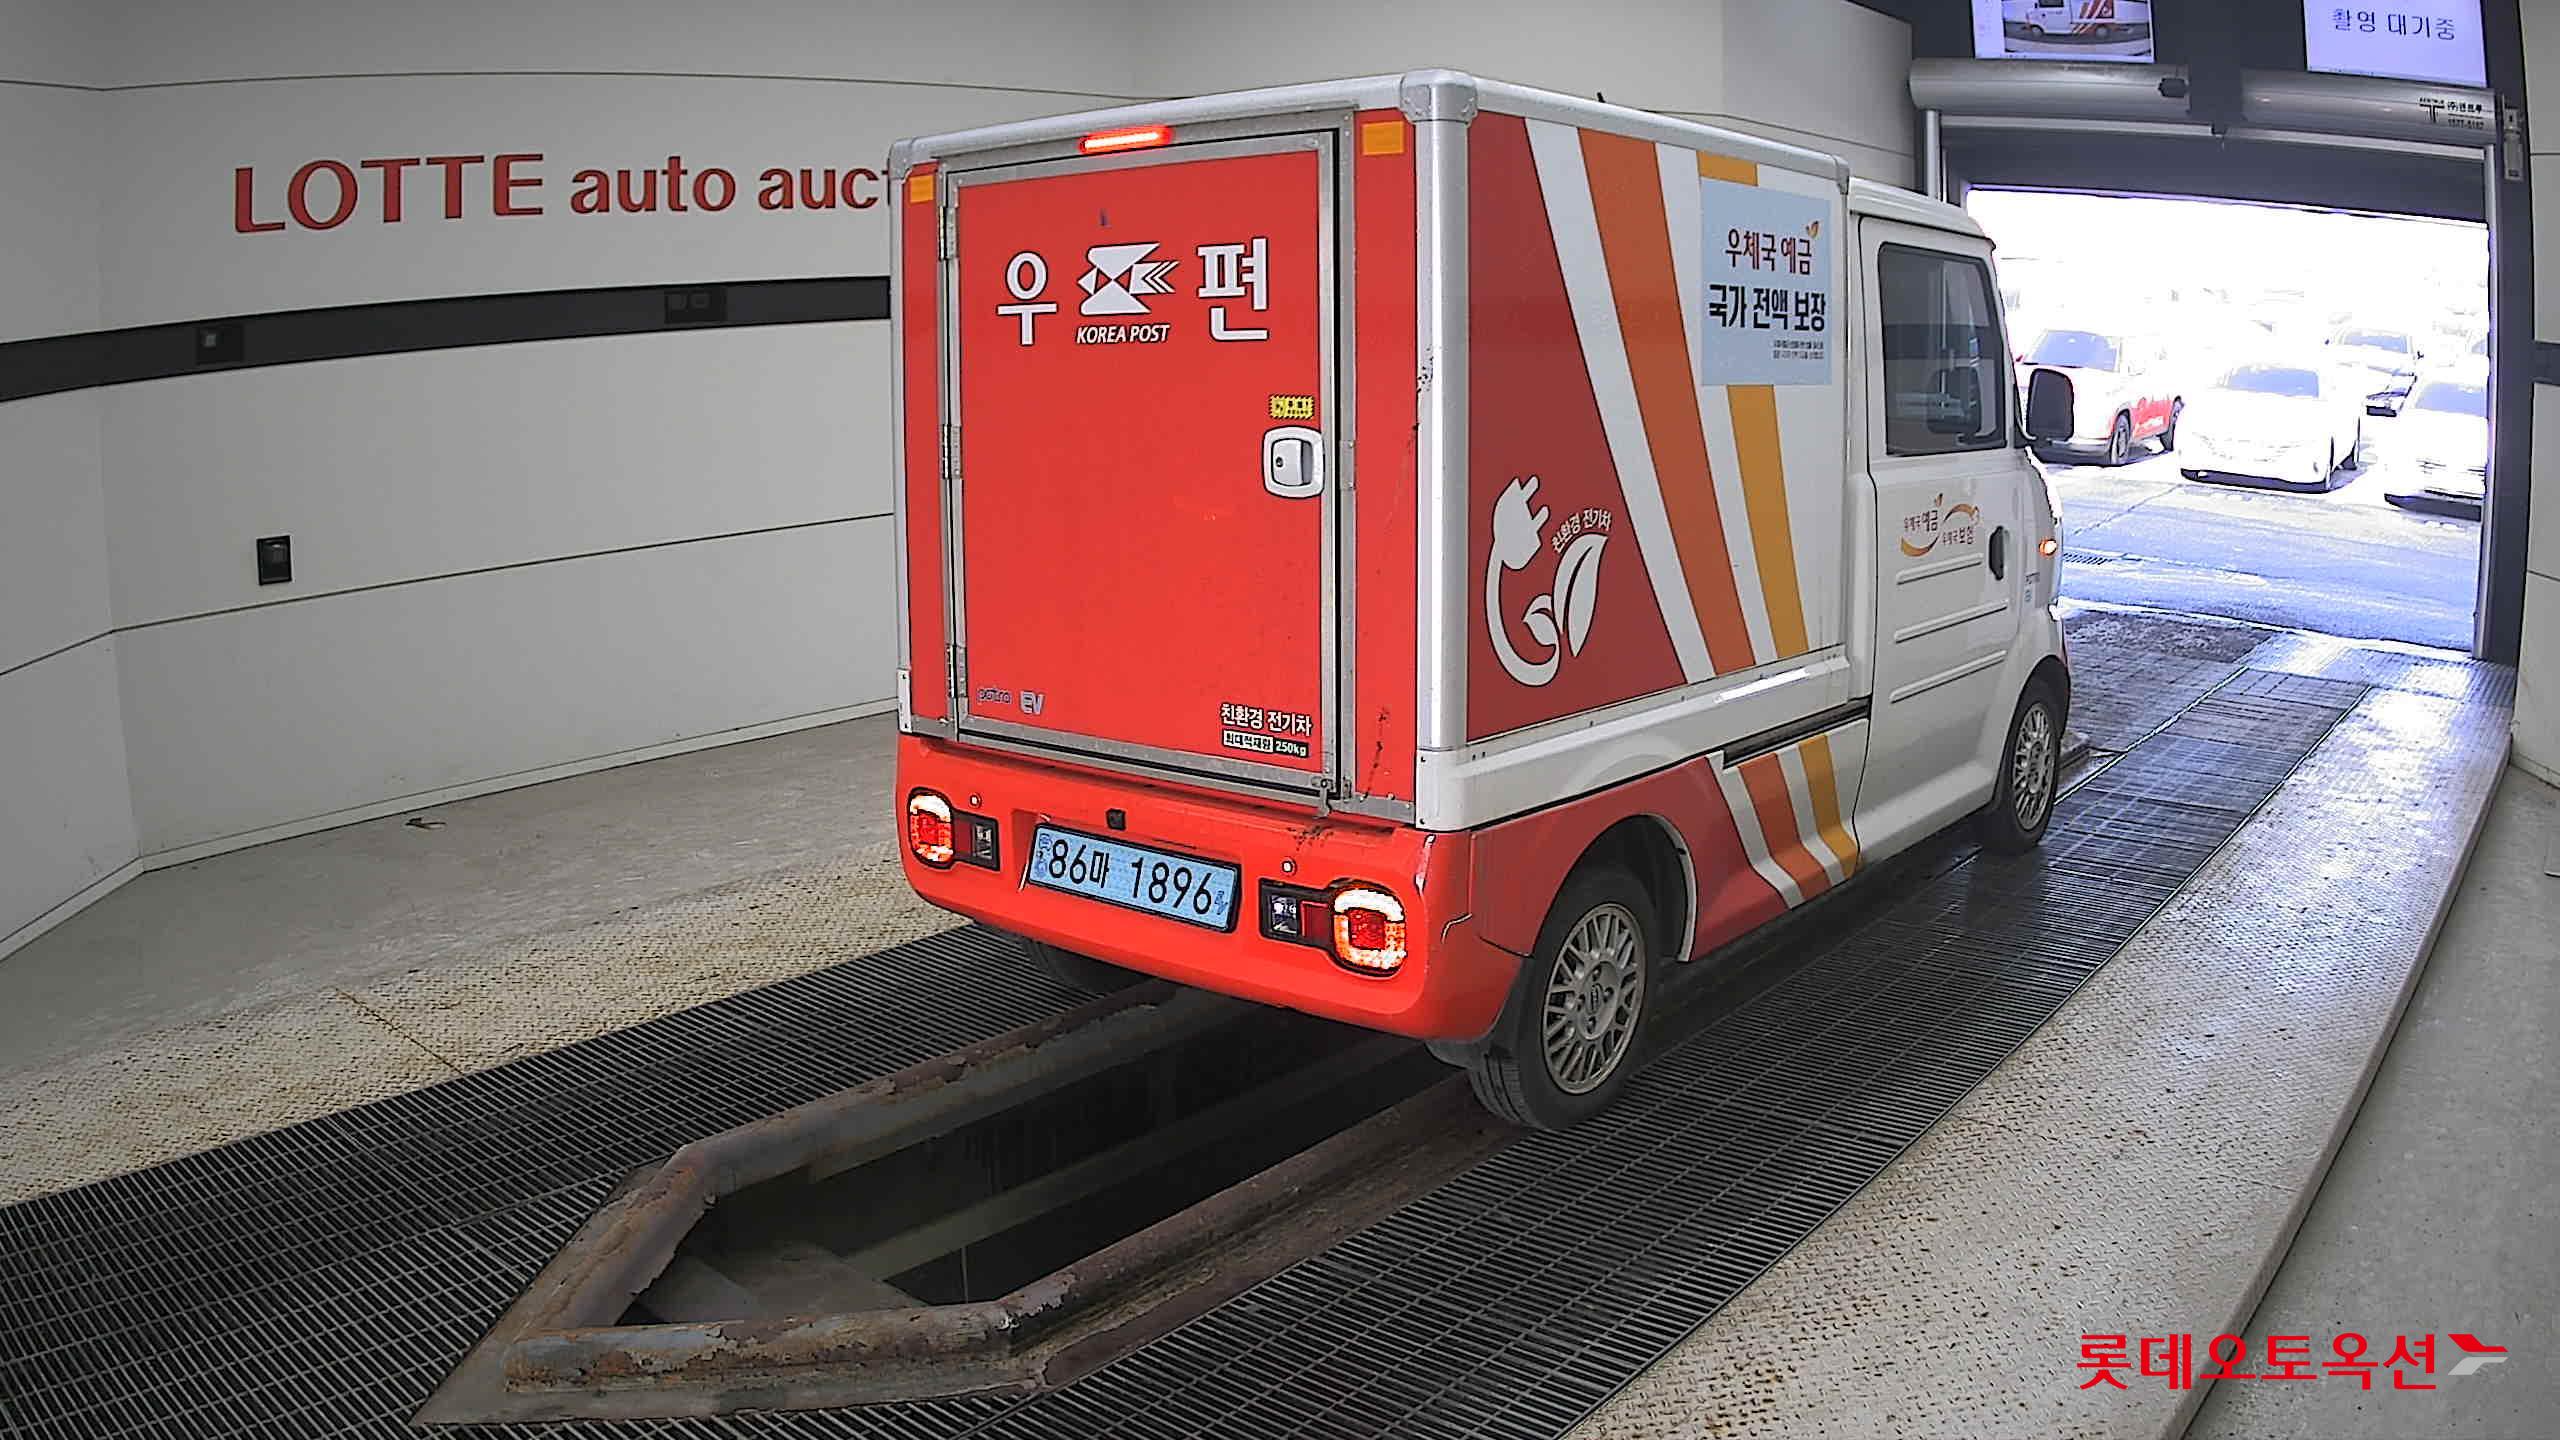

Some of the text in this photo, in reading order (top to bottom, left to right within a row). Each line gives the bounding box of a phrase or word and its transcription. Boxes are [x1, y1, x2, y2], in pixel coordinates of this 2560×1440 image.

[2332, 8, 2456, 41] 촬영 대기중
[233, 153, 889, 234] LOTTE auto auc
[1725, 228, 1813, 276] 우체국 예금
[996, 237, 1269, 346] 우 편
[1708, 283, 1827, 333] 국가 전액 보장
[1076, 324, 1171, 344] KOREA POST
[1551, 507, 1612, 554] 친환경 전기차
[1019, 690, 1046, 716] EV
[1220, 702, 1314, 738] 친환경 전기차
[1274, 740, 1308, 758] 250kg
[1049, 838, 1213, 915] 86마 1896
